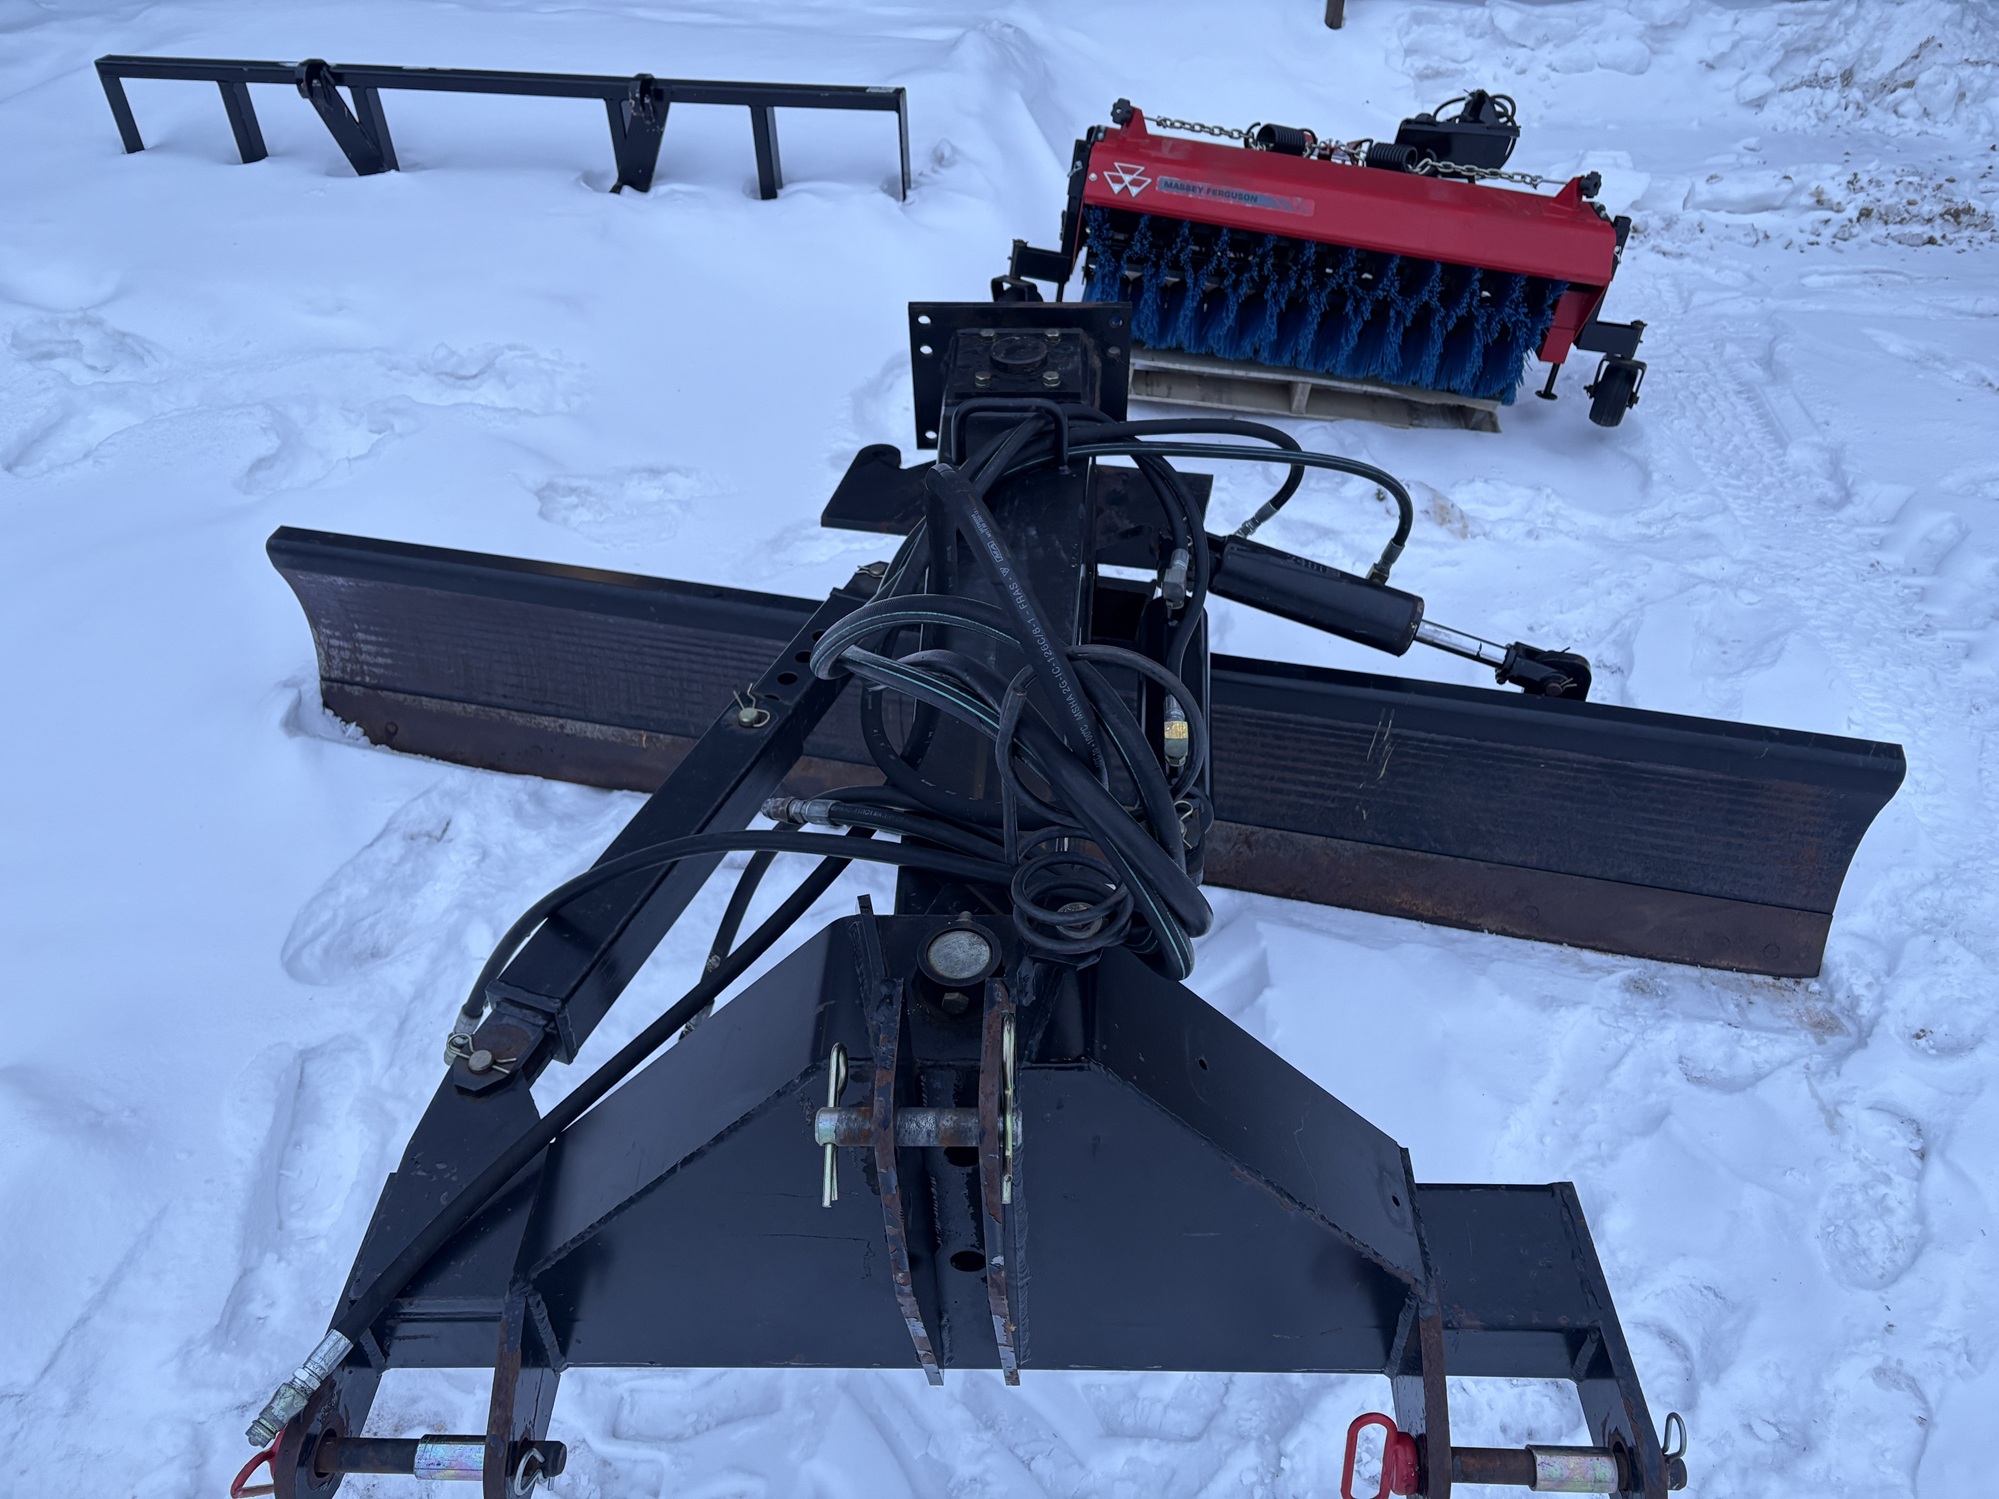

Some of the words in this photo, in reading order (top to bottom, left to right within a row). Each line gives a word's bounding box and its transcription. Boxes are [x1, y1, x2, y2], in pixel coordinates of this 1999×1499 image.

[1163, 181, 1204, 194] MASSEY
[1206, 188, 1258, 202] FERGUSON
[1009, 582, 1028, 610] FRAS
[1066, 693, 1083, 721] MSHA
